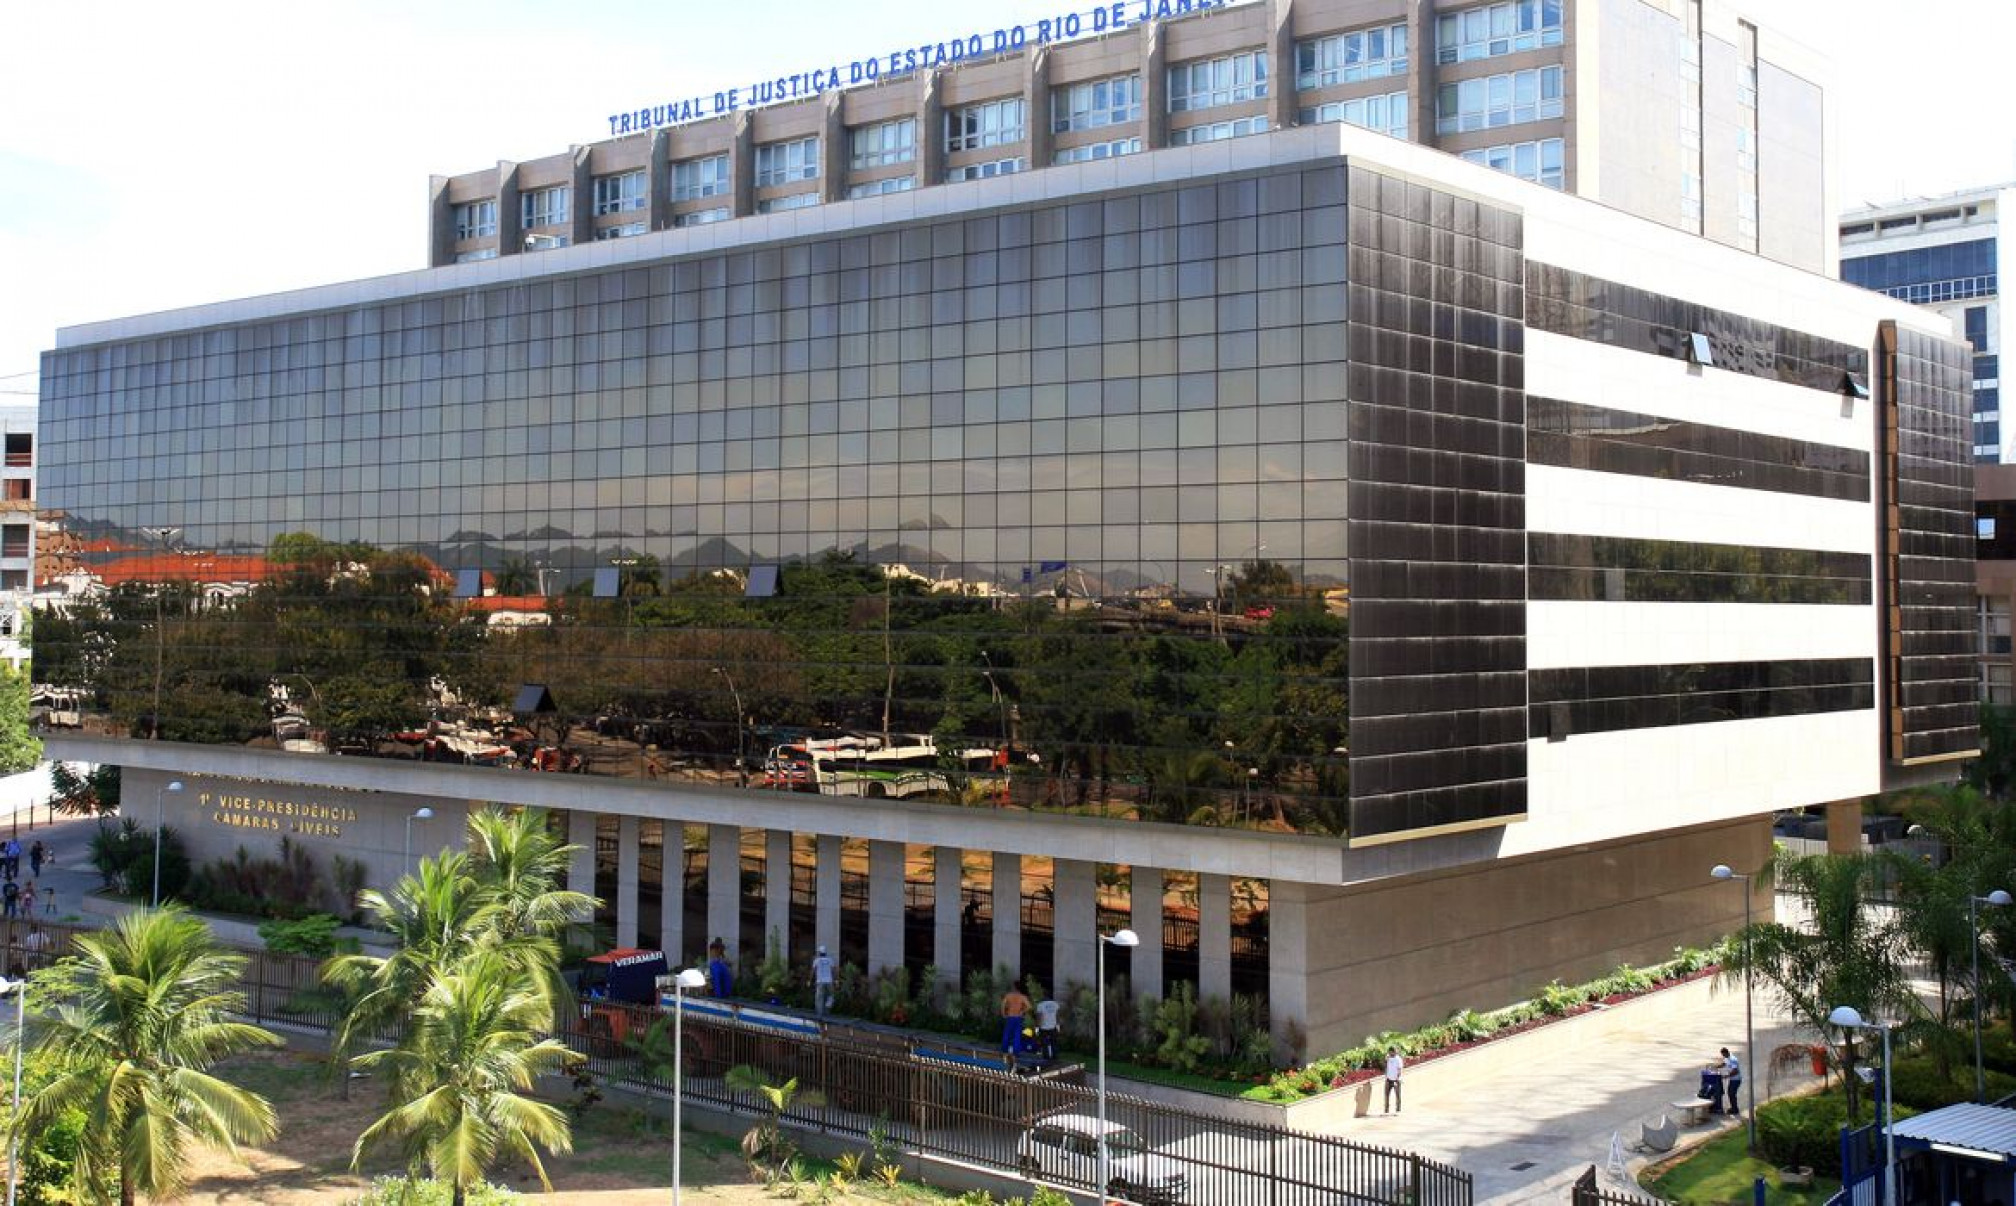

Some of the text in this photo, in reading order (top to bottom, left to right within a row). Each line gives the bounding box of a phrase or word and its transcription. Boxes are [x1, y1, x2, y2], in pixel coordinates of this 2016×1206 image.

[608, 97, 704, 135] TRIBUNAL
[714, 88, 739, 113] DE
[747, 66, 840, 106] JUSTIÇA
[850, 57, 879, 84] DO
[889, 34, 983, 75] ESTADO
[993, 25, 1025, 53] DO
[1038, 13, 1080, 44] RIO
[1093, 2, 1126, 32] DE
[614, 952, 663, 967] VERAMAR
